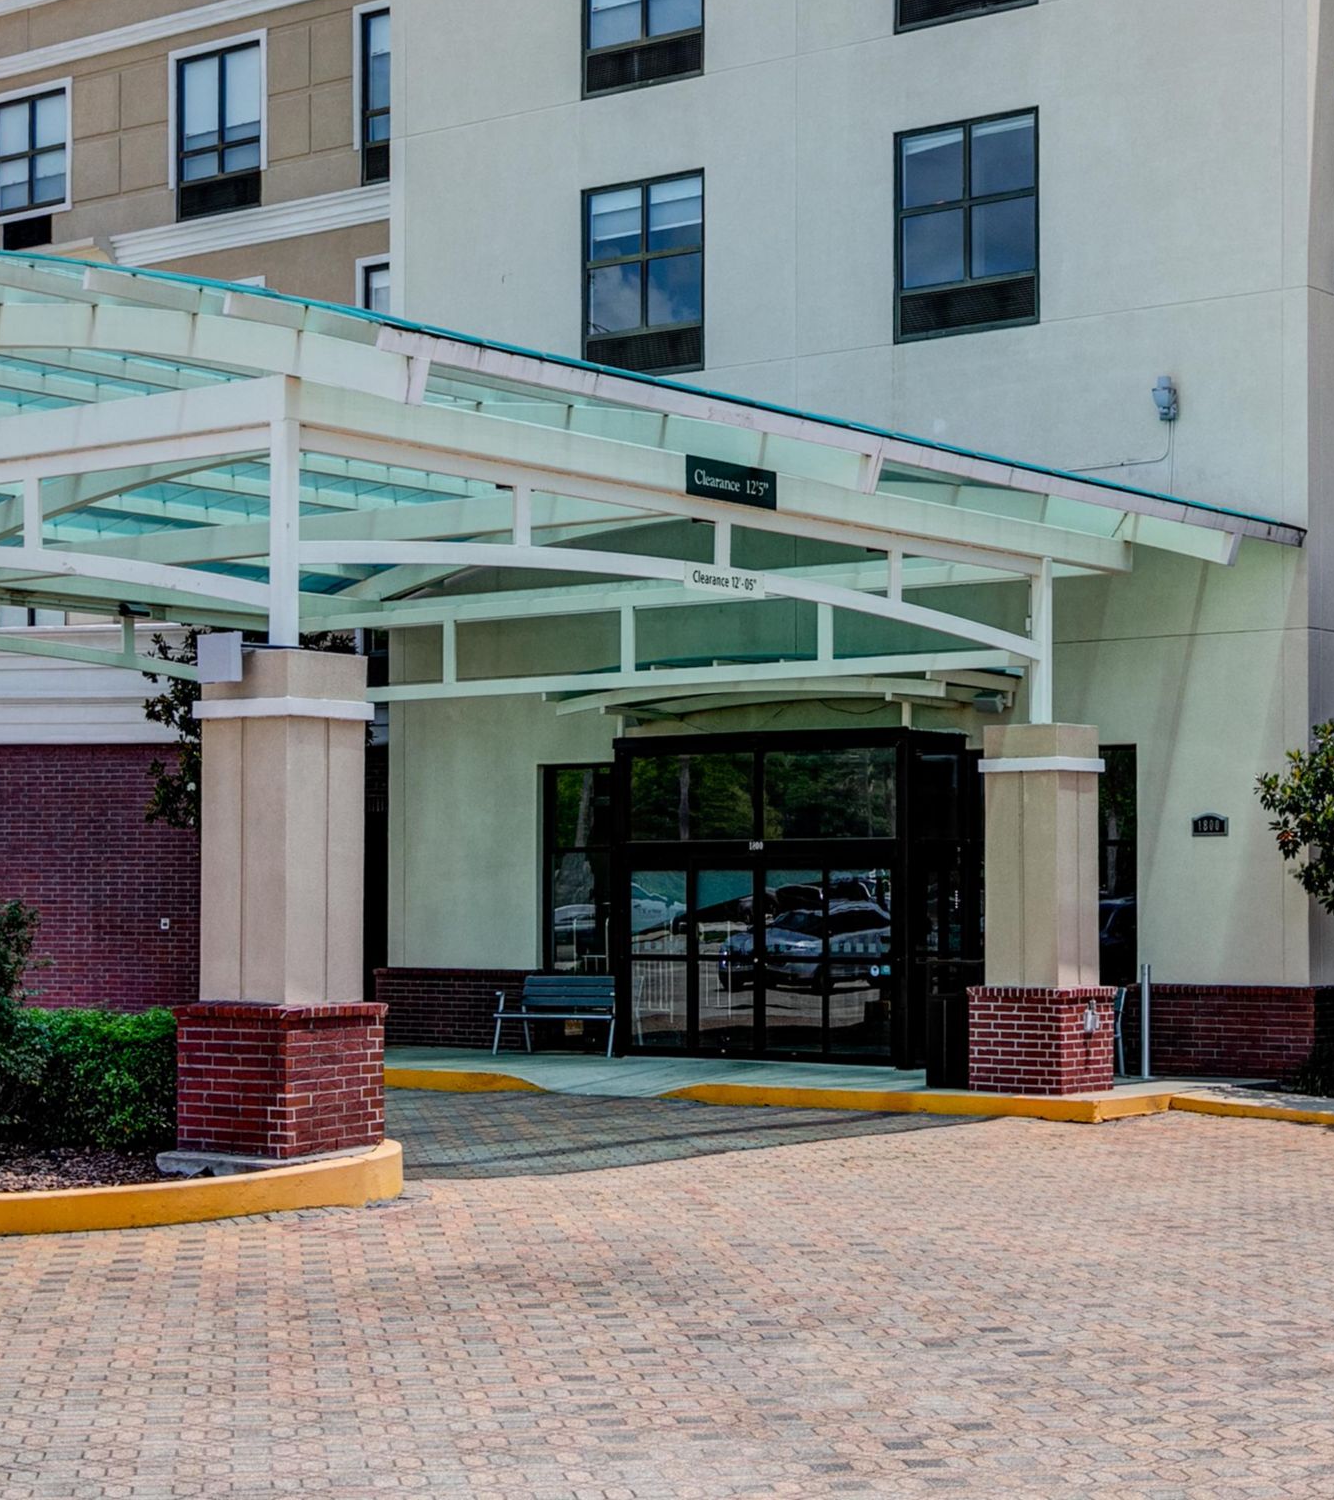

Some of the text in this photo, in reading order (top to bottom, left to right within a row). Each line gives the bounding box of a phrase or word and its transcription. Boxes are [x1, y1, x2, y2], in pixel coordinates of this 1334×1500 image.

[694, 469, 740, 492] Clearance
[693, 570, 729, 588] Clearance
[1198, 819, 1220, 831] 1800
